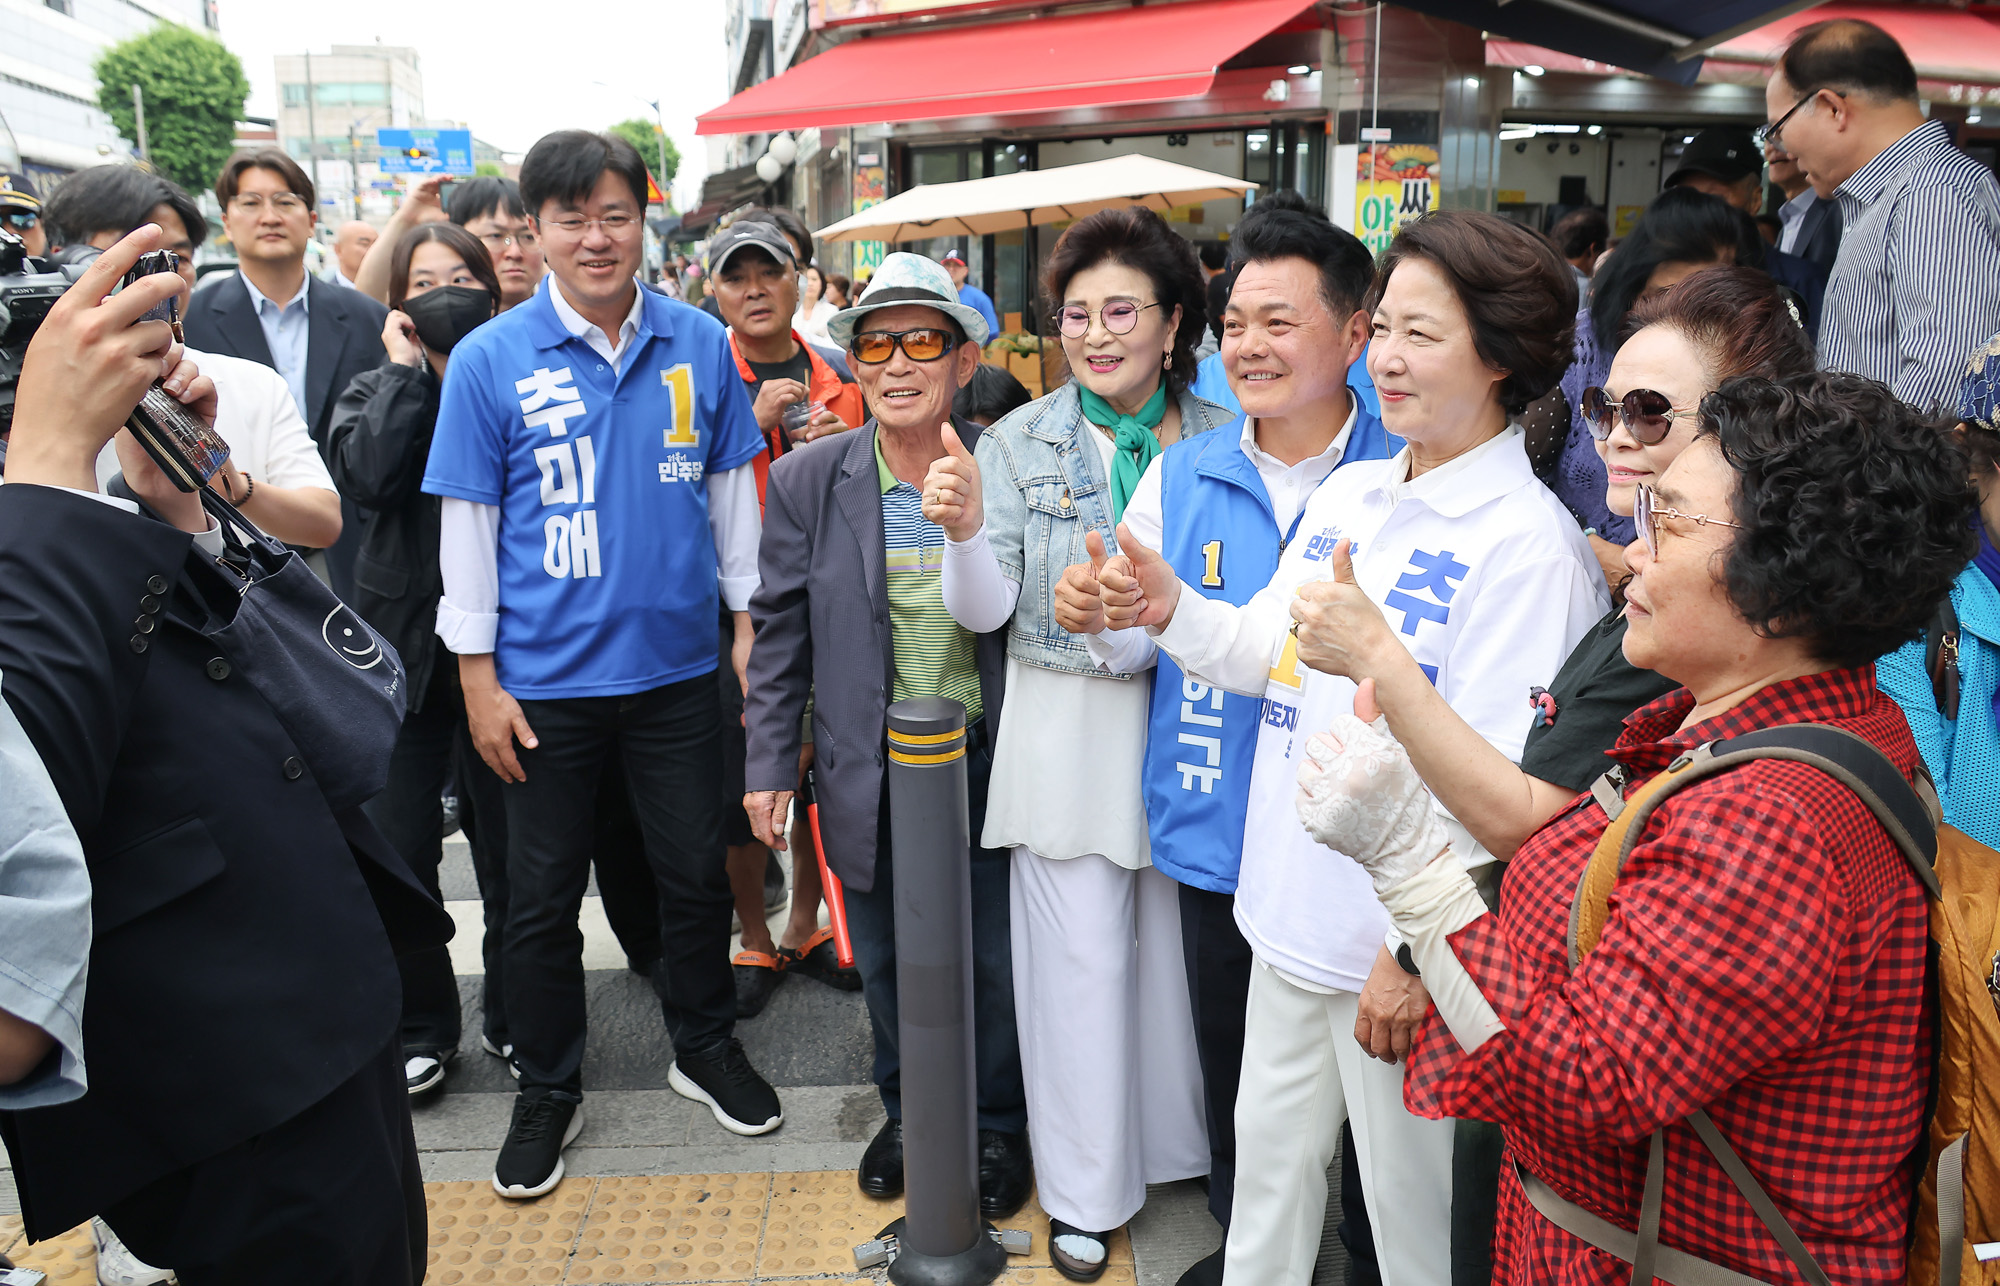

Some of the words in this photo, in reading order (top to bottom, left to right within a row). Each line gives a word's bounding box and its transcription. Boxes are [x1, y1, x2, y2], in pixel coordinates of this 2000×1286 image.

[1399, 181, 1431, 224] 싸
[10, 287, 36, 295] SONY
[659, 362, 701, 448] 1
[514, 366, 602, 580] 추미애
[658, 461, 704, 483] 민주당
[1201, 539, 1225, 591] 1
[1175, 676, 1226, 794] 인규
[1261, 697, 1302, 733] 기도지
